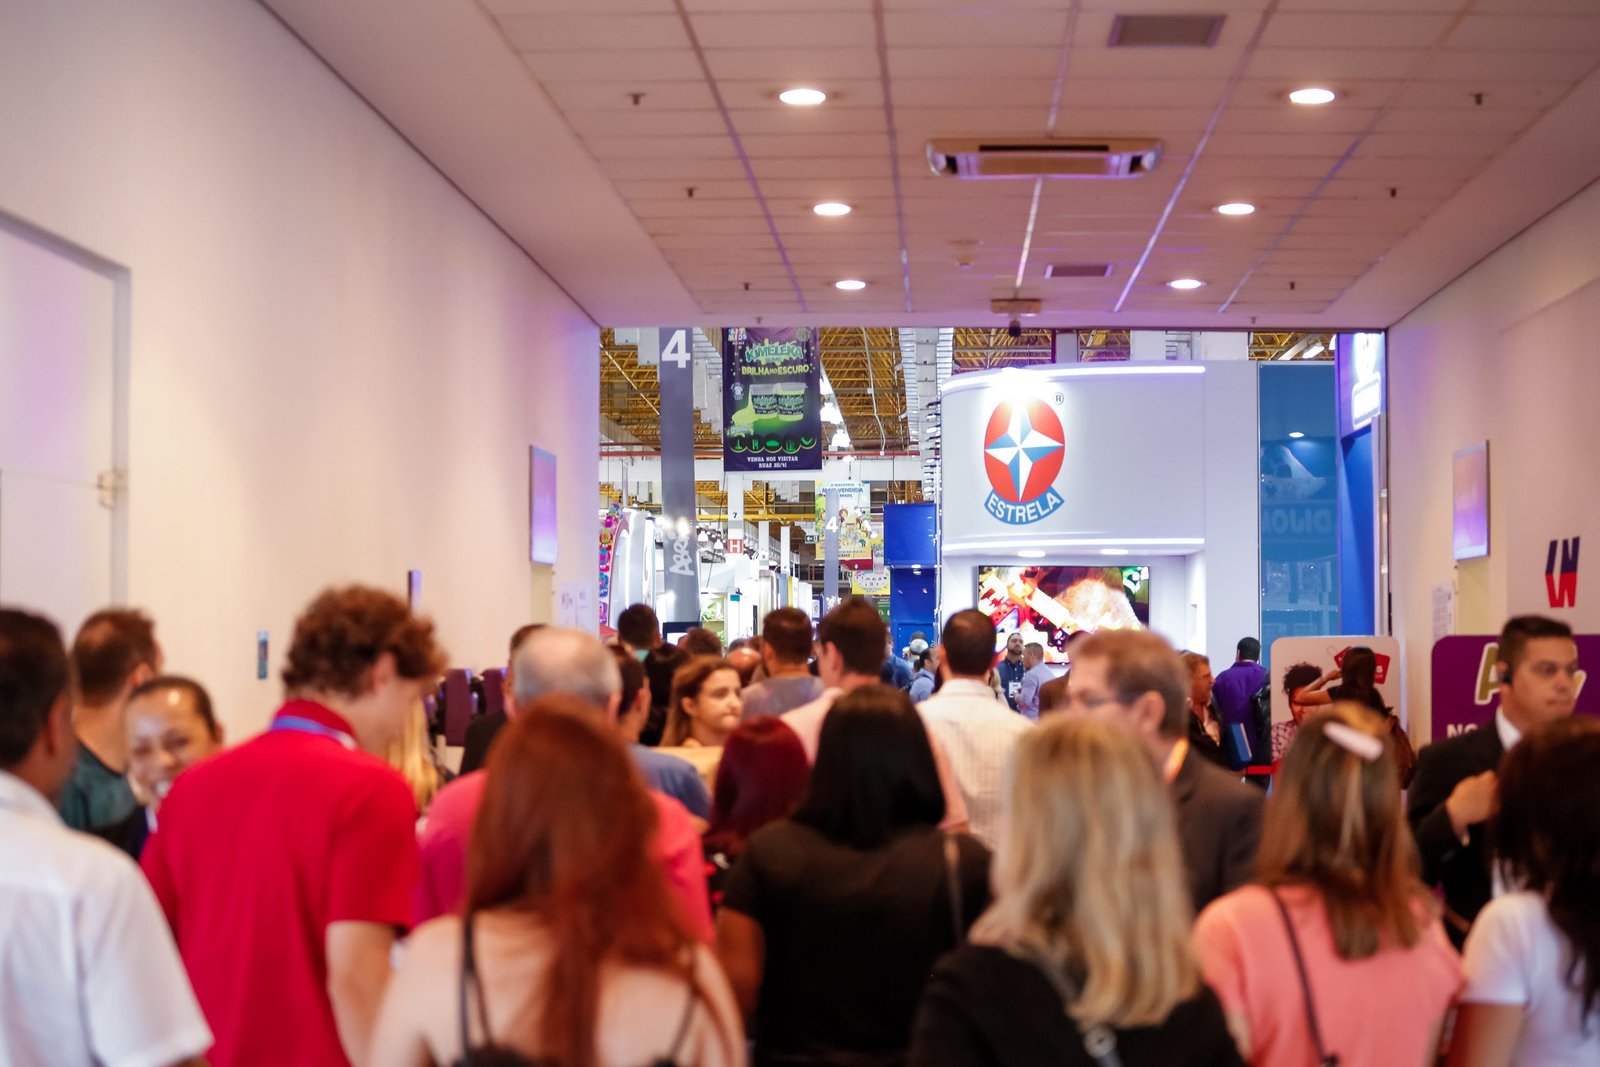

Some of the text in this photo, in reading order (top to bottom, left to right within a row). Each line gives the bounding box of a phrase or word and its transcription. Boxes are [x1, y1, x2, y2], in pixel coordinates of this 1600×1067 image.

[661, 329, 691, 369] 4
[741, 366, 770, 375] BRILHA
[777, 364, 810, 375] ESCURO
[987, 492, 1061, 523] ESTRELA
[825, 516, 839, 533] 4
[729, 540, 741, 553] H
